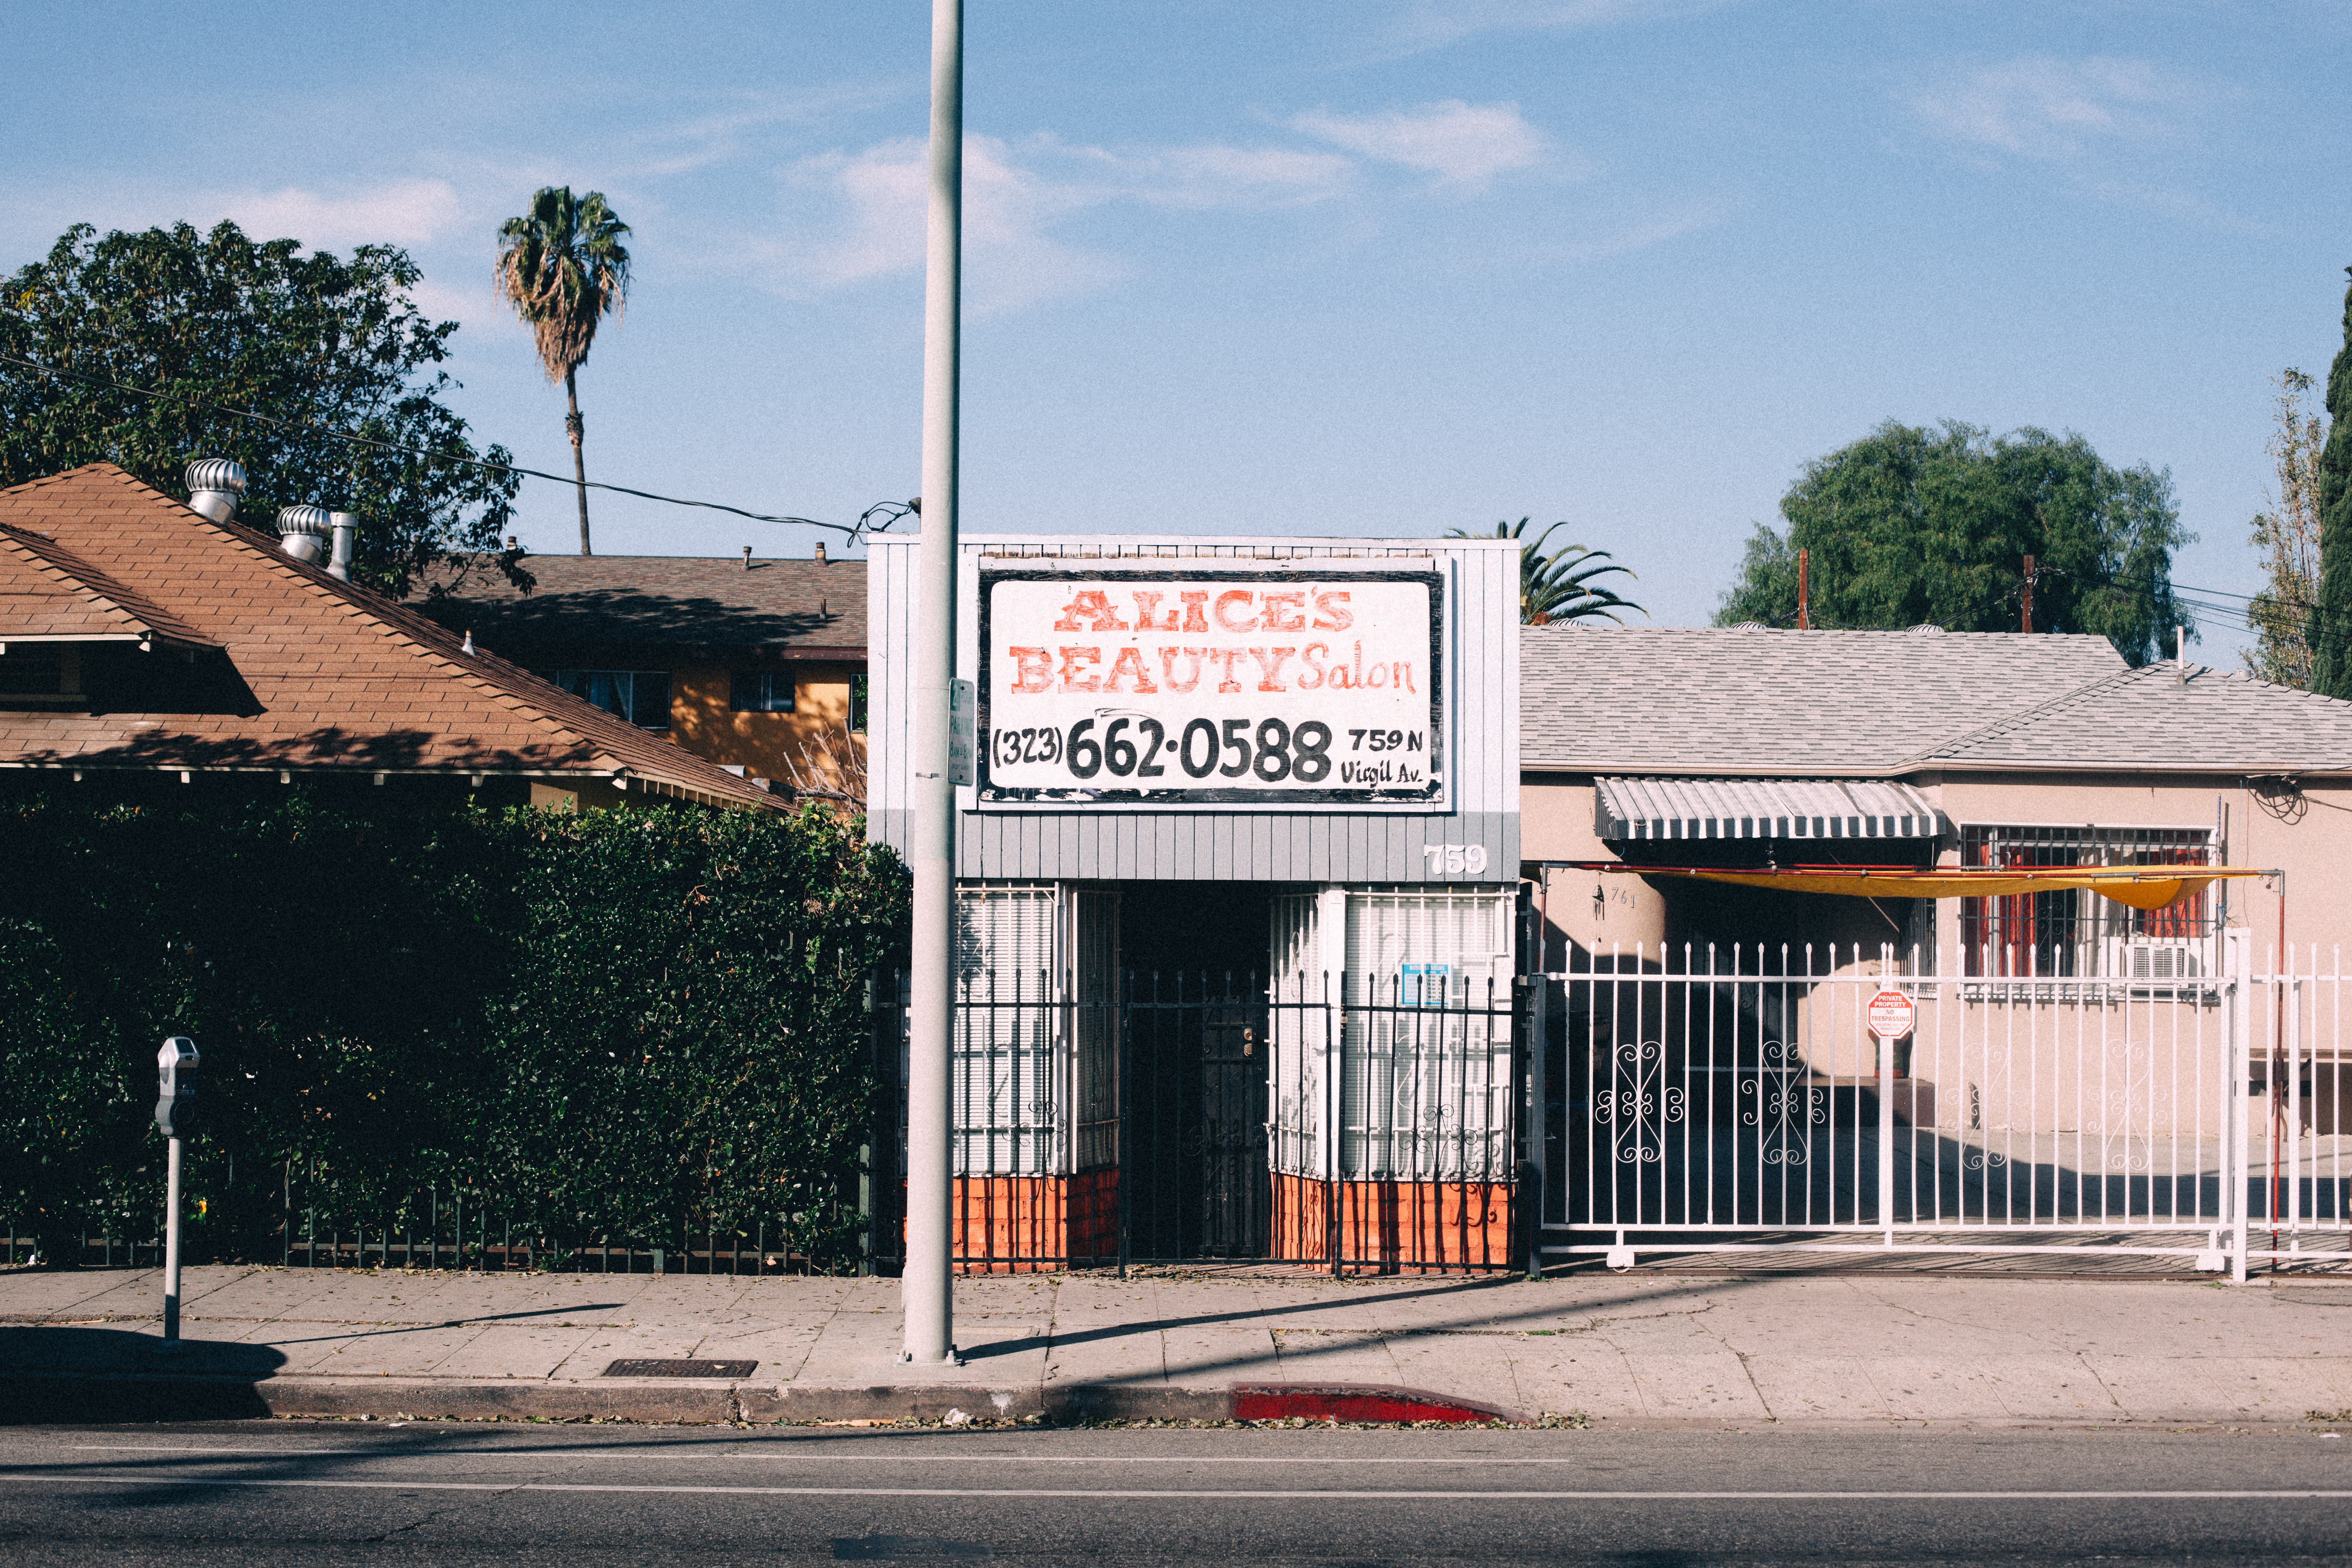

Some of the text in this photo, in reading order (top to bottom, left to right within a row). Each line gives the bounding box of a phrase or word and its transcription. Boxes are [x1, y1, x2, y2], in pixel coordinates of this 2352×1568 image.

[1053, 585, 1354, 633] ALICE'S
[1009, 639, 1416, 694] BEAUTY Salon
[953, 684, 973, 706] 2 HOUR
[950, 715, 973, 737] PARKING
[1349, 729, 1422, 751] 759 N
[993, 727, 1062, 768] (323)
[1341, 759, 1423, 788] Virgil Av.
[1424, 844, 1488, 875] 759
[1611, 887, 1635, 908] 761
